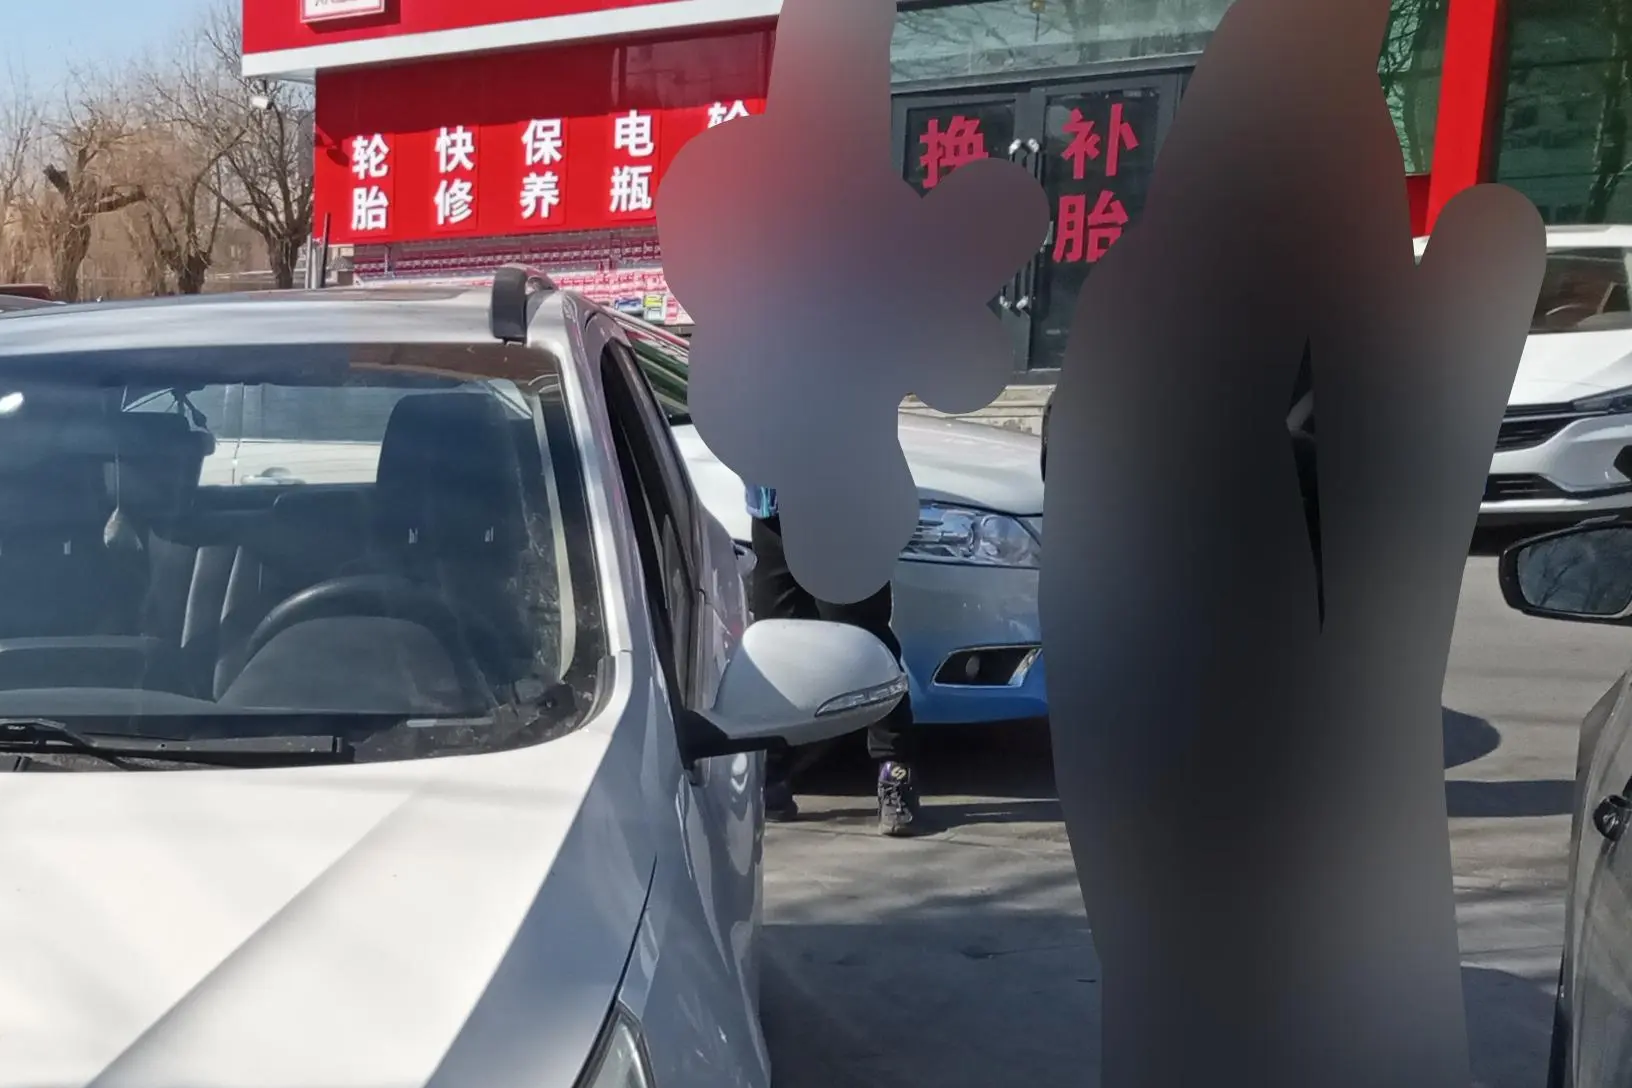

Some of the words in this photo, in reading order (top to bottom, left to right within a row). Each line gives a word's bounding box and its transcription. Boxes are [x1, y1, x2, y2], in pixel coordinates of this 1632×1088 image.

[352, 133, 389, 231] 轮胎
[433, 125, 475, 225] 快修
[520, 118, 563, 219] 保养
[609, 109, 654, 213] 电瓶
[1052, 103, 1139, 263] 补胎
